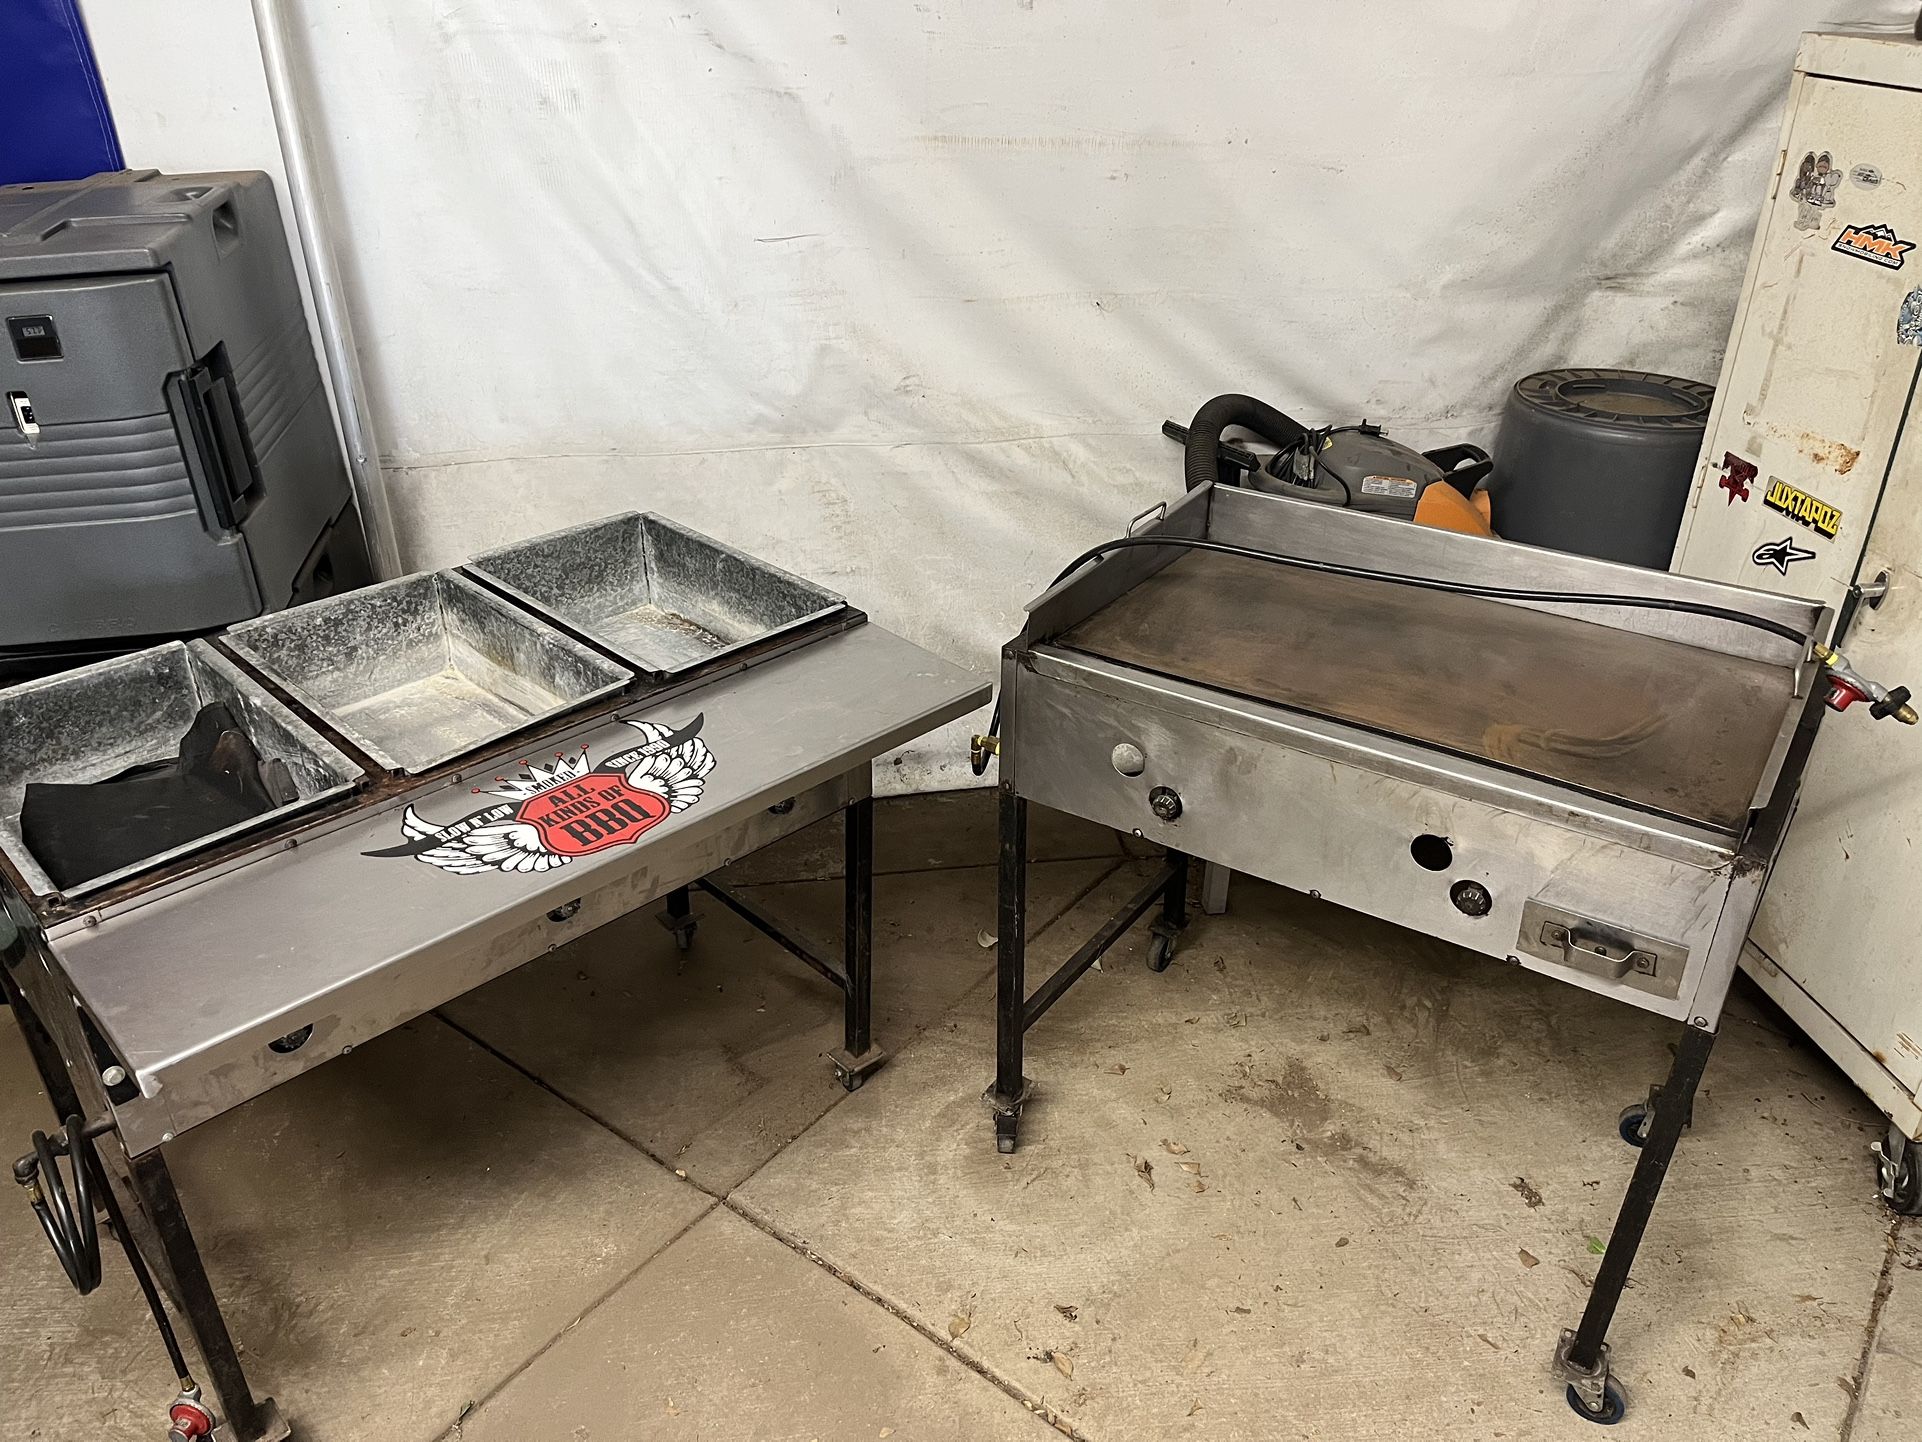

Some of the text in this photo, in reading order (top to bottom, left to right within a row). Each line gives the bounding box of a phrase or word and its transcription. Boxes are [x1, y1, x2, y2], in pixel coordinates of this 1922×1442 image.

[1840, 229, 1906, 259] HMK
[1765, 481, 1842, 538] JUXTAPOZ
[604, 750, 644, 768] SINCE
[525, 770, 577, 795] SMOKED
[548, 783, 596, 808] ALL
[434, 821, 471, 843] SLOW
[483, 803, 514, 822] LOW
[537, 784, 625, 828] KINDS OF
[559, 798, 657, 847] BBQ
